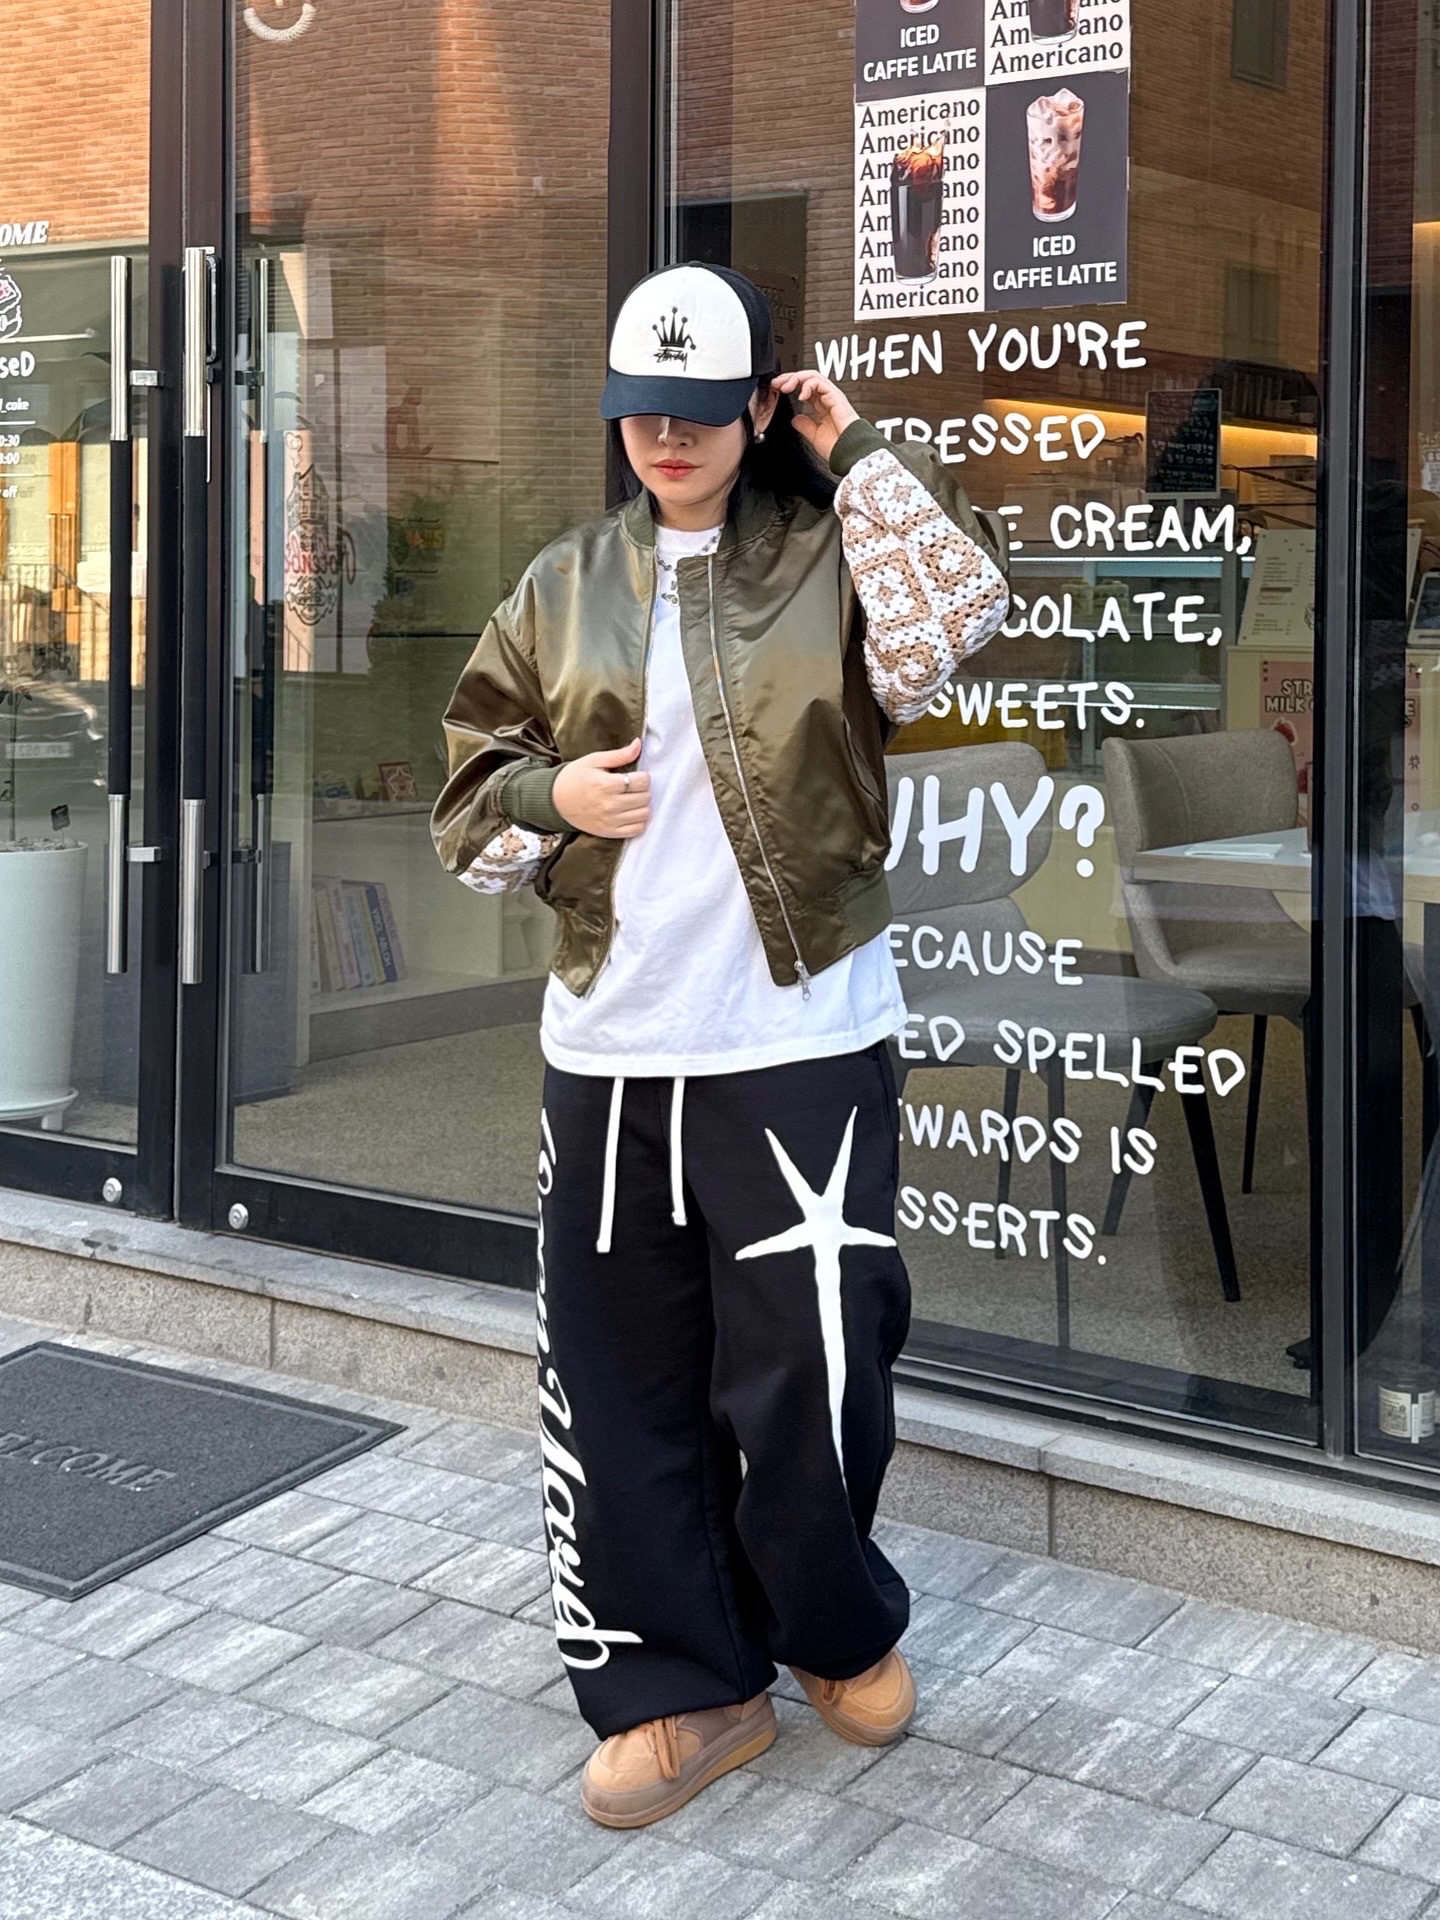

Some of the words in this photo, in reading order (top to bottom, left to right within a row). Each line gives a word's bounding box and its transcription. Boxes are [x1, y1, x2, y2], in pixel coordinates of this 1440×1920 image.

[900, 24, 940, 48] ICED
[990, 14, 1123, 48] Amano
[863, 56, 919, 82] CAFFE
[922, 48, 977, 75] LATTE
[990, 42, 1123, 75] Americano
[859, 99, 980, 128] Americano
[859, 153, 980, 181] Amano
[859, 180, 979, 207] Amano
[0, 221, 49, 247] OME
[859, 207, 979, 233] Amano
[859, 233, 979, 259] Amano
[1033, 235, 1076, 257] ICED
[859, 260, 979, 285] Amano
[993, 267, 1052, 291] CAFFE
[1057, 261, 1117, 286] LATTE
[859, 285, 979, 311] Americano
[815, 329, 944, 381] WHEN
[968, 321, 1147, 372] YOU'RE
[875, 413, 1106, 464] TRESSED
[1050, 502, 1252, 555] CREAM,
[1000, 591, 1223, 646] COLATE,
[1281, 679, 1313, 696] STR
[928, 681, 1145, 730] SWEETS.
[1264, 696, 1305, 713] MILK
[886, 923, 1083, 985] ECAUSE
[893, 1014, 966, 1061] ED
[993, 1019, 1246, 1097] SPELLED
[898, 1098, 1082, 1163] WARDS
[1110, 1126, 1157, 1175] IS
[897, 1186, 1107, 1265] SSERTS.
